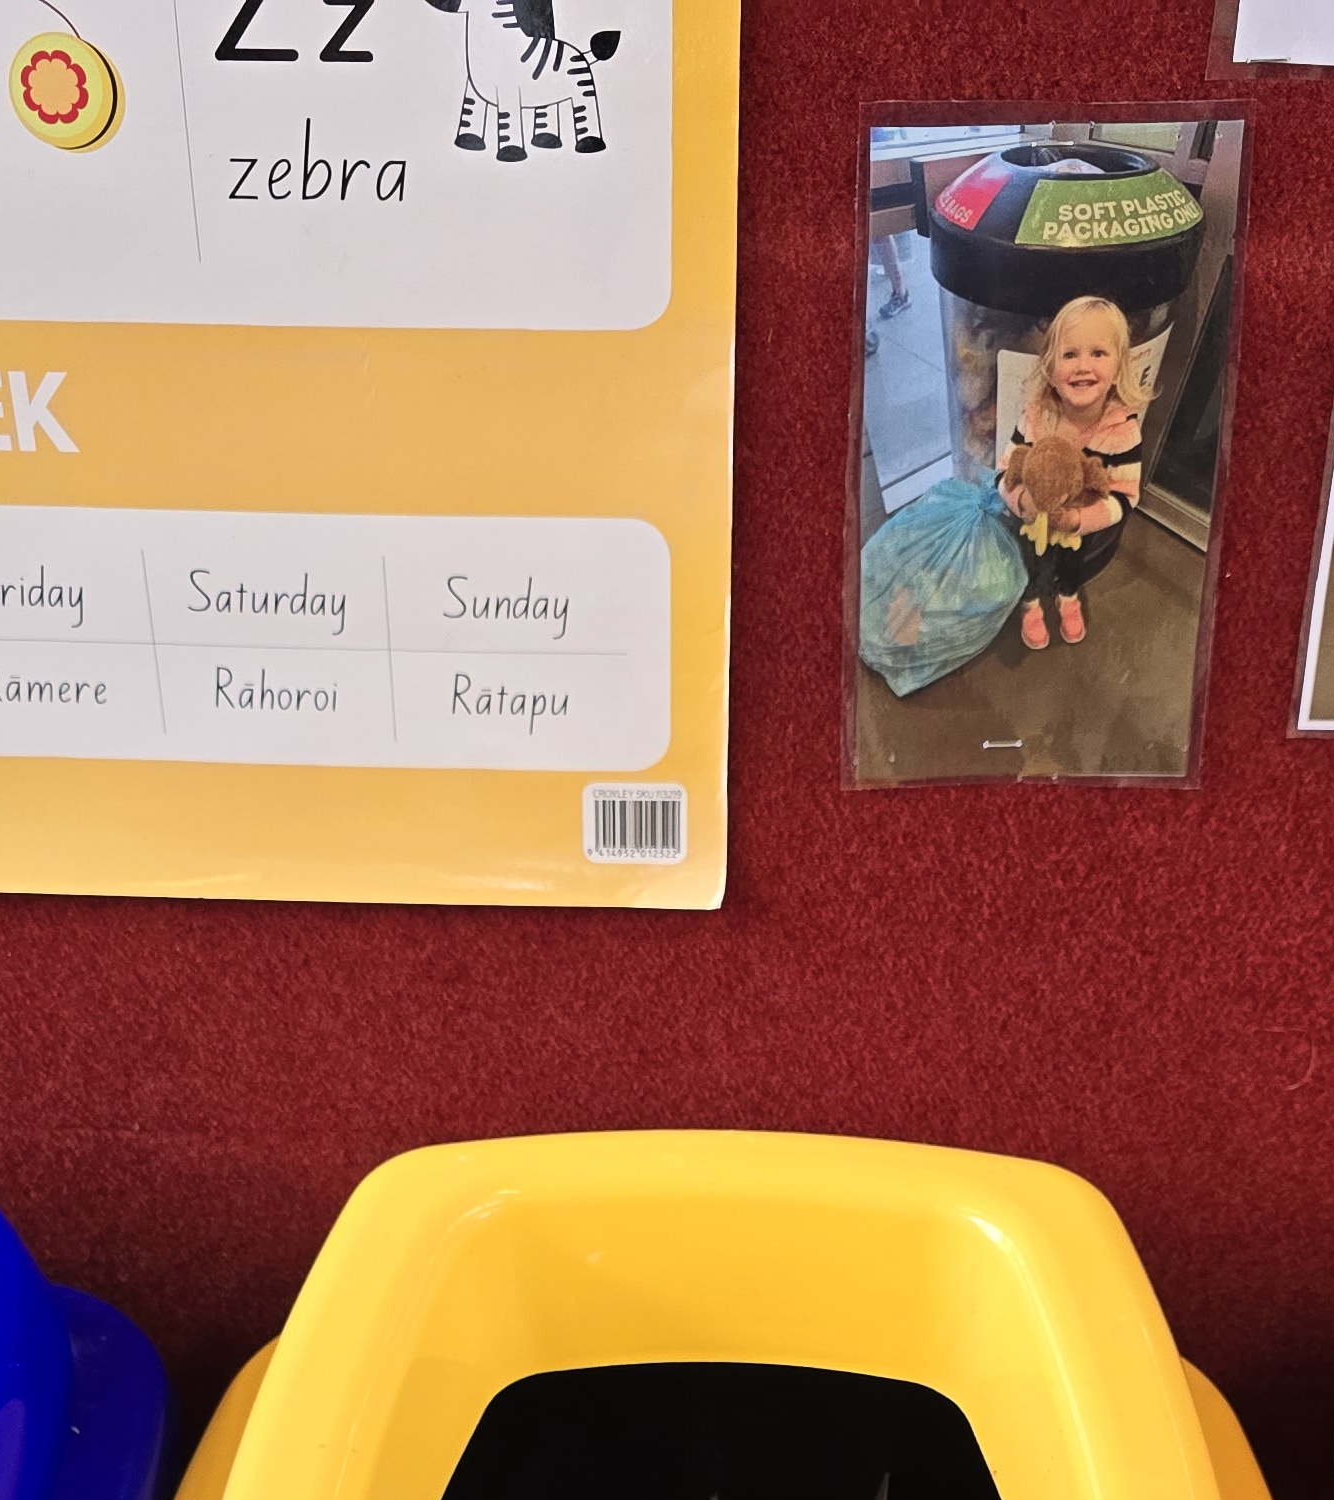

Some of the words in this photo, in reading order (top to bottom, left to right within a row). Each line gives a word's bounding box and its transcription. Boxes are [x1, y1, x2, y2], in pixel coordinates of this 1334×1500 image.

[229, 118, 406, 201] zebra
[1043, 210, 1173, 240] PACKAGING
[1059, 201, 1117, 221] SOFT
[1121, 190, 1185, 216] PLASTIC
[188, 570, 345, 635] Saturday
[443, 576, 569, 639] Sunday
[216, 667, 336, 711] Rāhoroi
[453, 674, 568, 734] Rātapu
